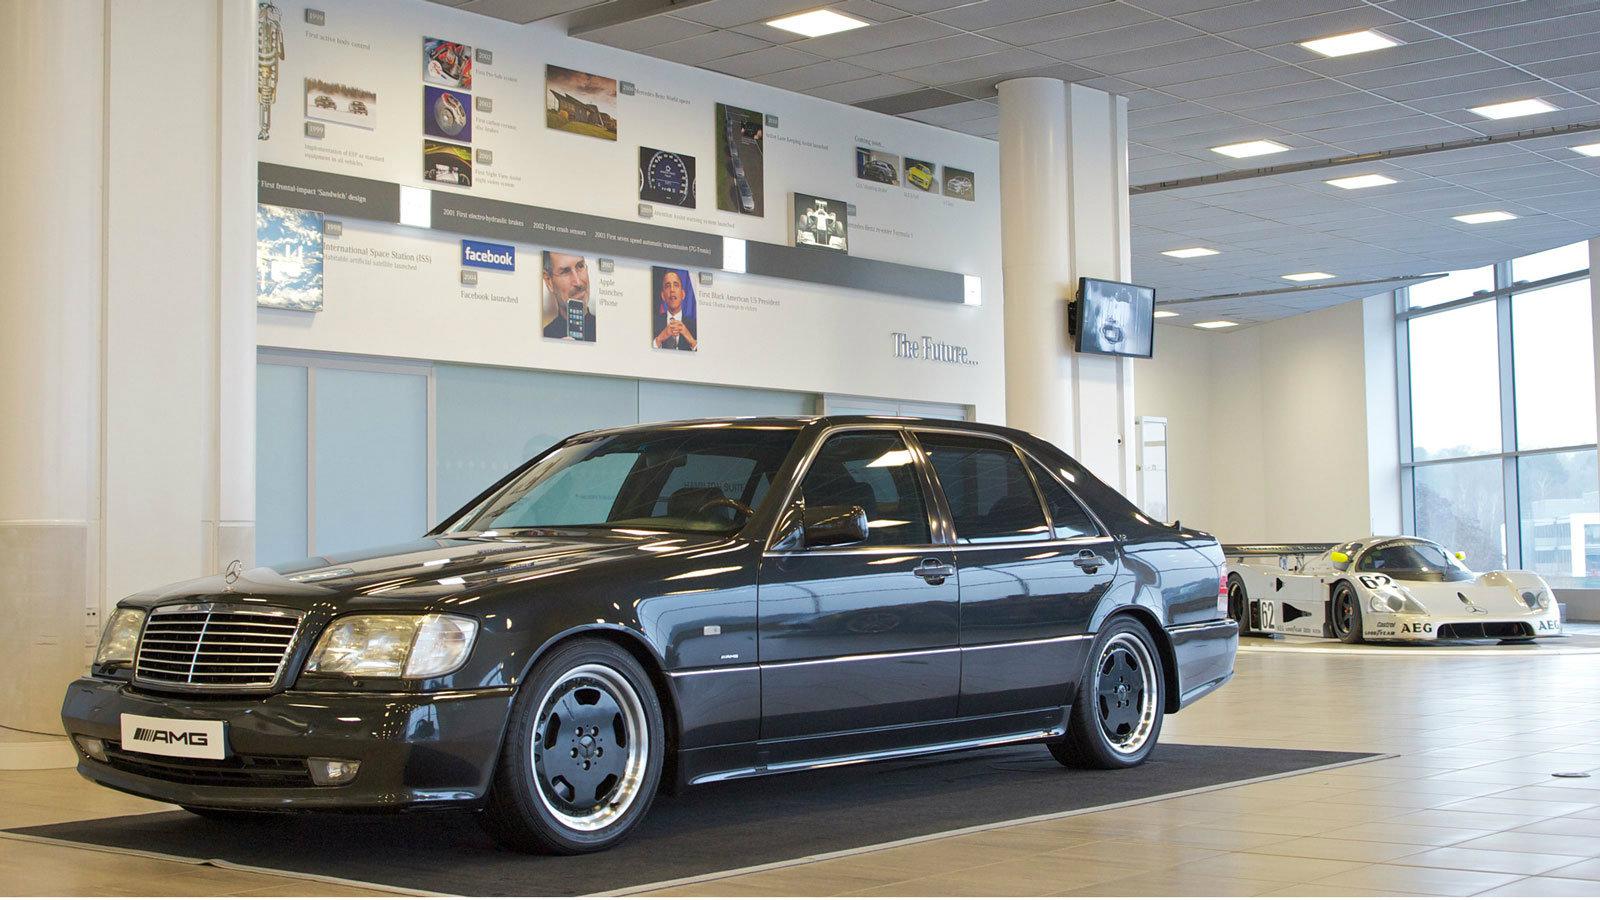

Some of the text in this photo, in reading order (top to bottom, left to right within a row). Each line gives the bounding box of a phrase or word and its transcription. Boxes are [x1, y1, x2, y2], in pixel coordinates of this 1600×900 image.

[305, 31, 318, 39] First
[351, 41, 370, 50] control
[854, 135, 872, 146] Coming
[261, 180, 275, 188] First
[276, 182, 317, 195] frontal-impact
[348, 193, 367, 203] design
[443, 208, 524, 227] 2001 First electro-hydraulic brakes
[533, 222, 587, 236] 2002 First crash sensors
[595, 231, 606, 239] 2003
[630, 237, 643, 245] speed
[323, 243, 432, 264] International Space Station (ISS)
[465, 246, 513, 266] facebook
[350, 256, 372, 265] artificial
[373, 259, 393, 268] satellite
[394, 262, 418, 271] launched
[599, 278, 615, 288] Apple
[461, 290, 519, 304] Facebook launched
[599, 288, 624, 297] launches
[698, 290, 780, 306] First Black American US President
[599, 298, 618, 307] iPhone
[892, 332, 919, 359] The
[1359, 576, 1397, 590] 62
[1262, 602, 1275, 629] 62
[1365, 629, 1396, 637] GOODYEAR
[1401, 622, 1433, 634] AEG
[151, 729, 208, 747] AMG
